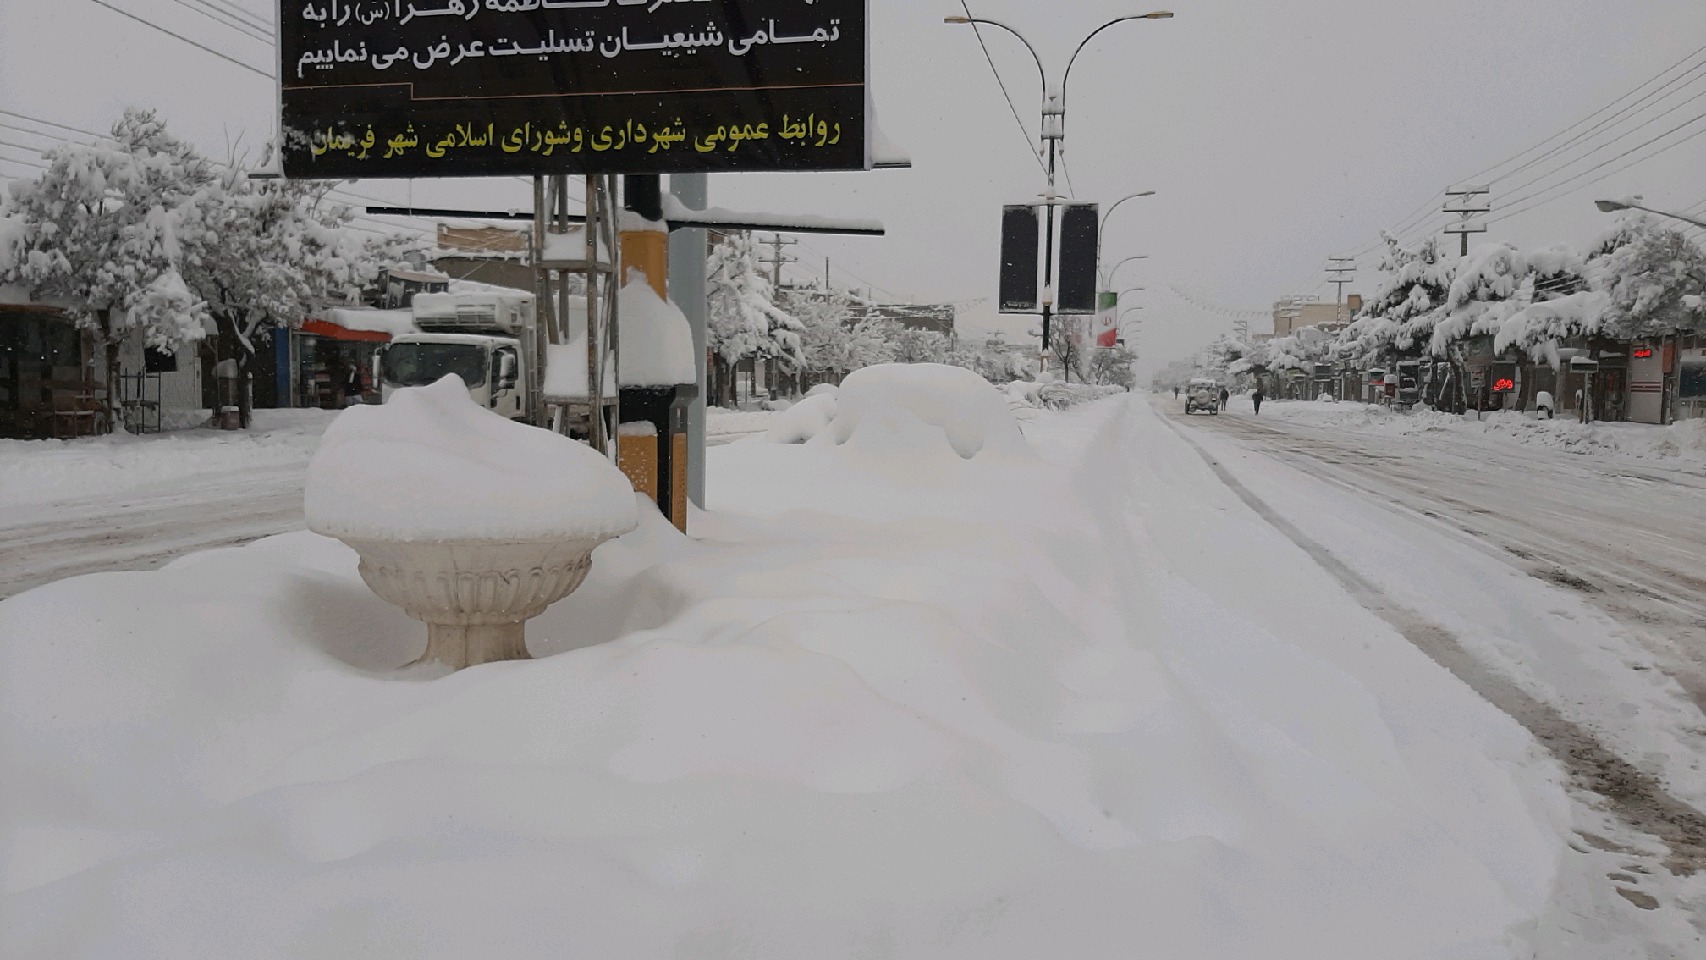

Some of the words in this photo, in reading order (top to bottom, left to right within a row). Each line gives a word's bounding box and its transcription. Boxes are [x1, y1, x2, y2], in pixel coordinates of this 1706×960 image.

[412, 35, 486, 70] عرض
[488, 29, 595, 63] تسلیت
[600, 21, 724, 58] شیعیان
[728, 18, 840, 56] تمامی
[297, 39, 368, 79] نماییم
[371, 46, 409, 70] می
[382, 121, 419, 159] شهر
[425, 121, 494, 158] اسلامی
[590, 117, 686, 153] شهرداری
[694, 120, 769, 153] عمومی
[778, 112, 841, 147] روابط
